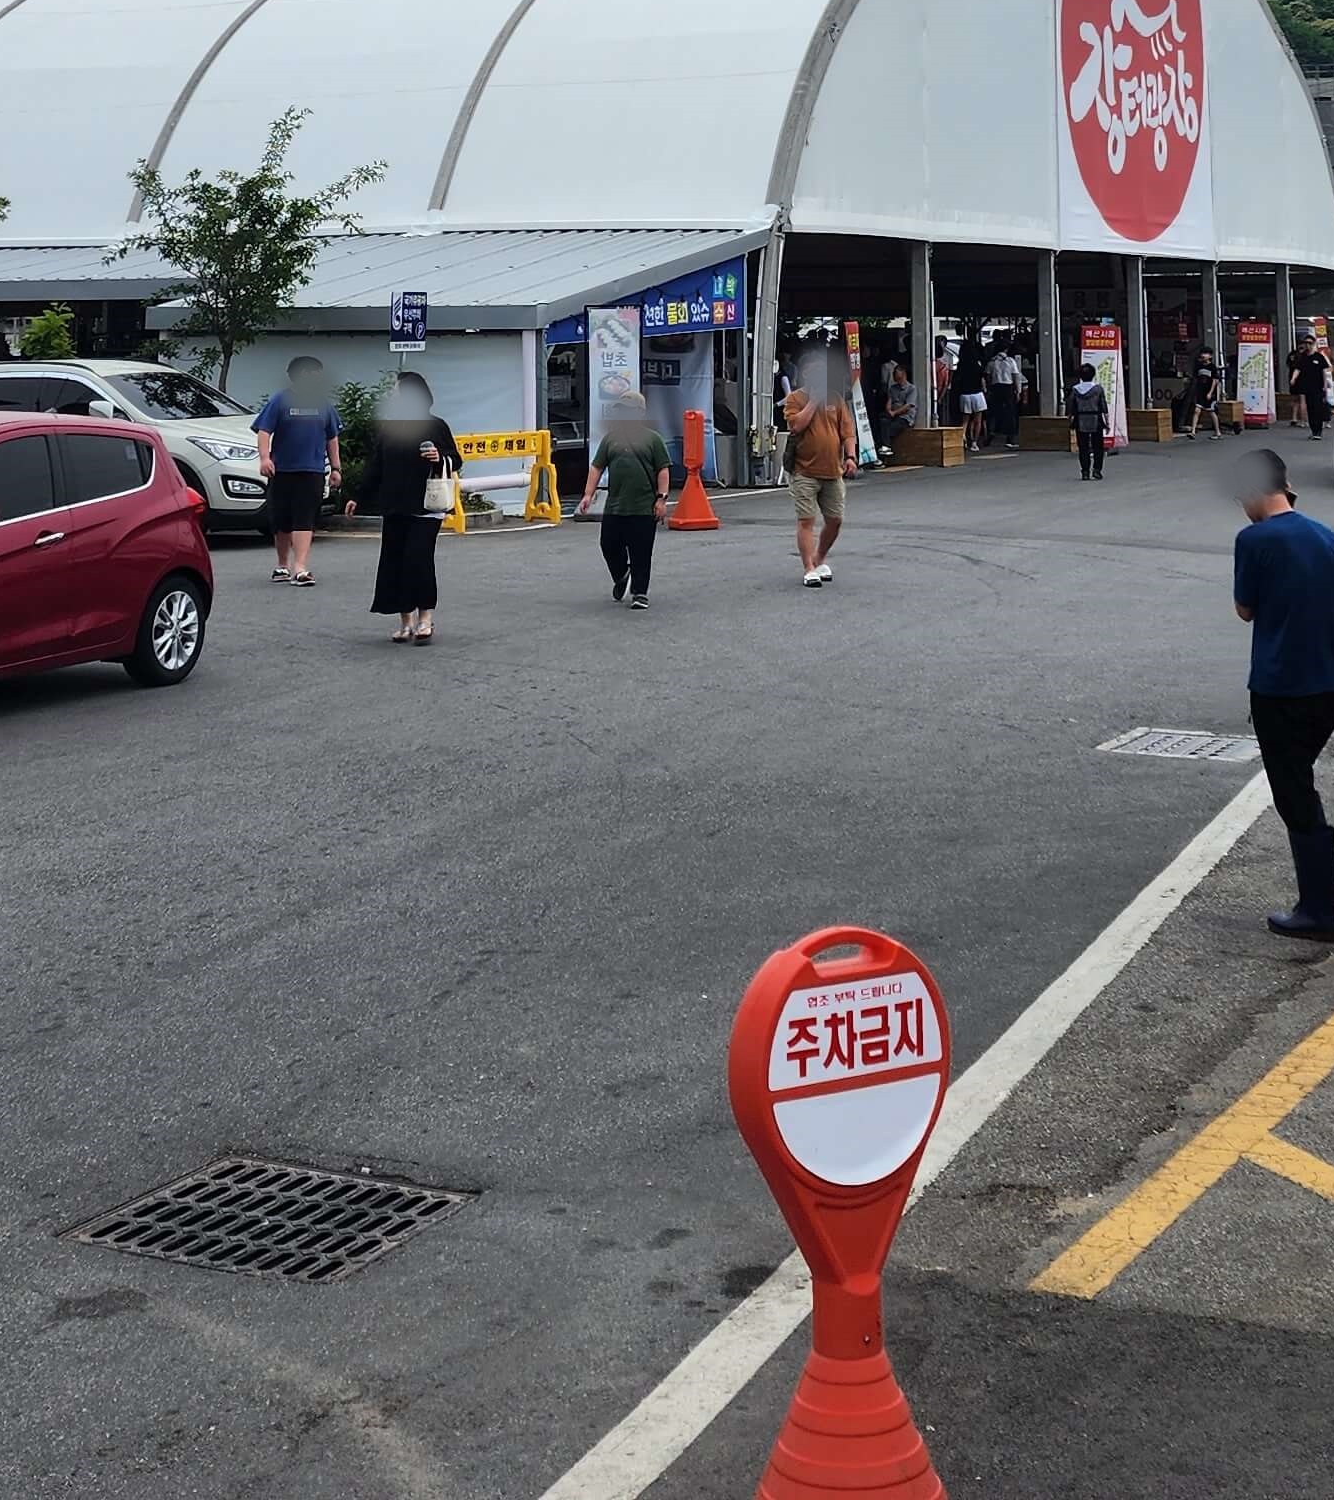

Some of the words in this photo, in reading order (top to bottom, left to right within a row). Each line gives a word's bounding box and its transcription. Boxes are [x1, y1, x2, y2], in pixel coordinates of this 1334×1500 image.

[667, 302, 688, 324] 물회
[463, 440, 486, 455] 안전
[834, 990, 856, 1003] 부탁
[860, 982, 903, 1000] 드립니다
[786, 998, 924, 1078] 주차금지
